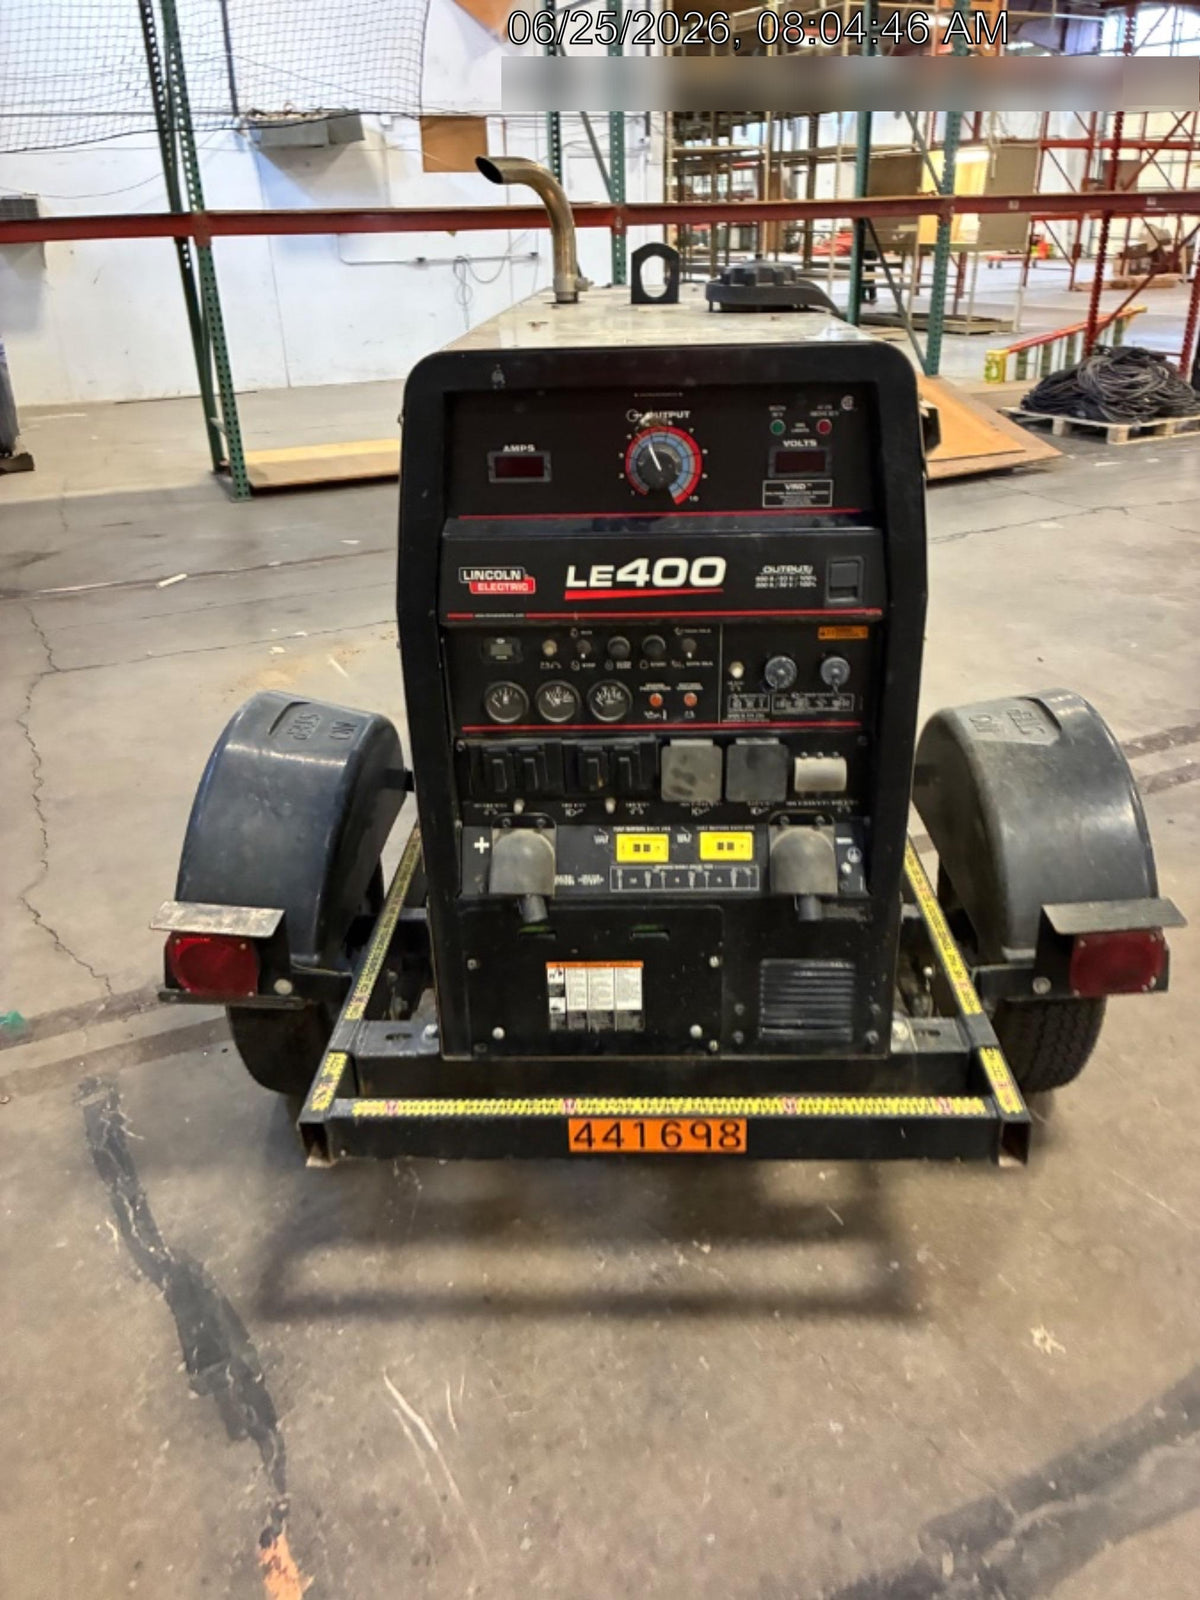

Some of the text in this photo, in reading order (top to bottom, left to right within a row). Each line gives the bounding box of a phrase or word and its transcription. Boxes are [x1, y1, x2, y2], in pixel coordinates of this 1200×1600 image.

[502, 443, 536, 452] AMPS
[782, 439, 818, 447] VOLTS
[463, 569, 521, 581] LINCOLN
[565, 556, 727, 588] LE400
[477, 582, 529, 592] ELECTRIC
[573, 1120, 742, 1148] 441698
